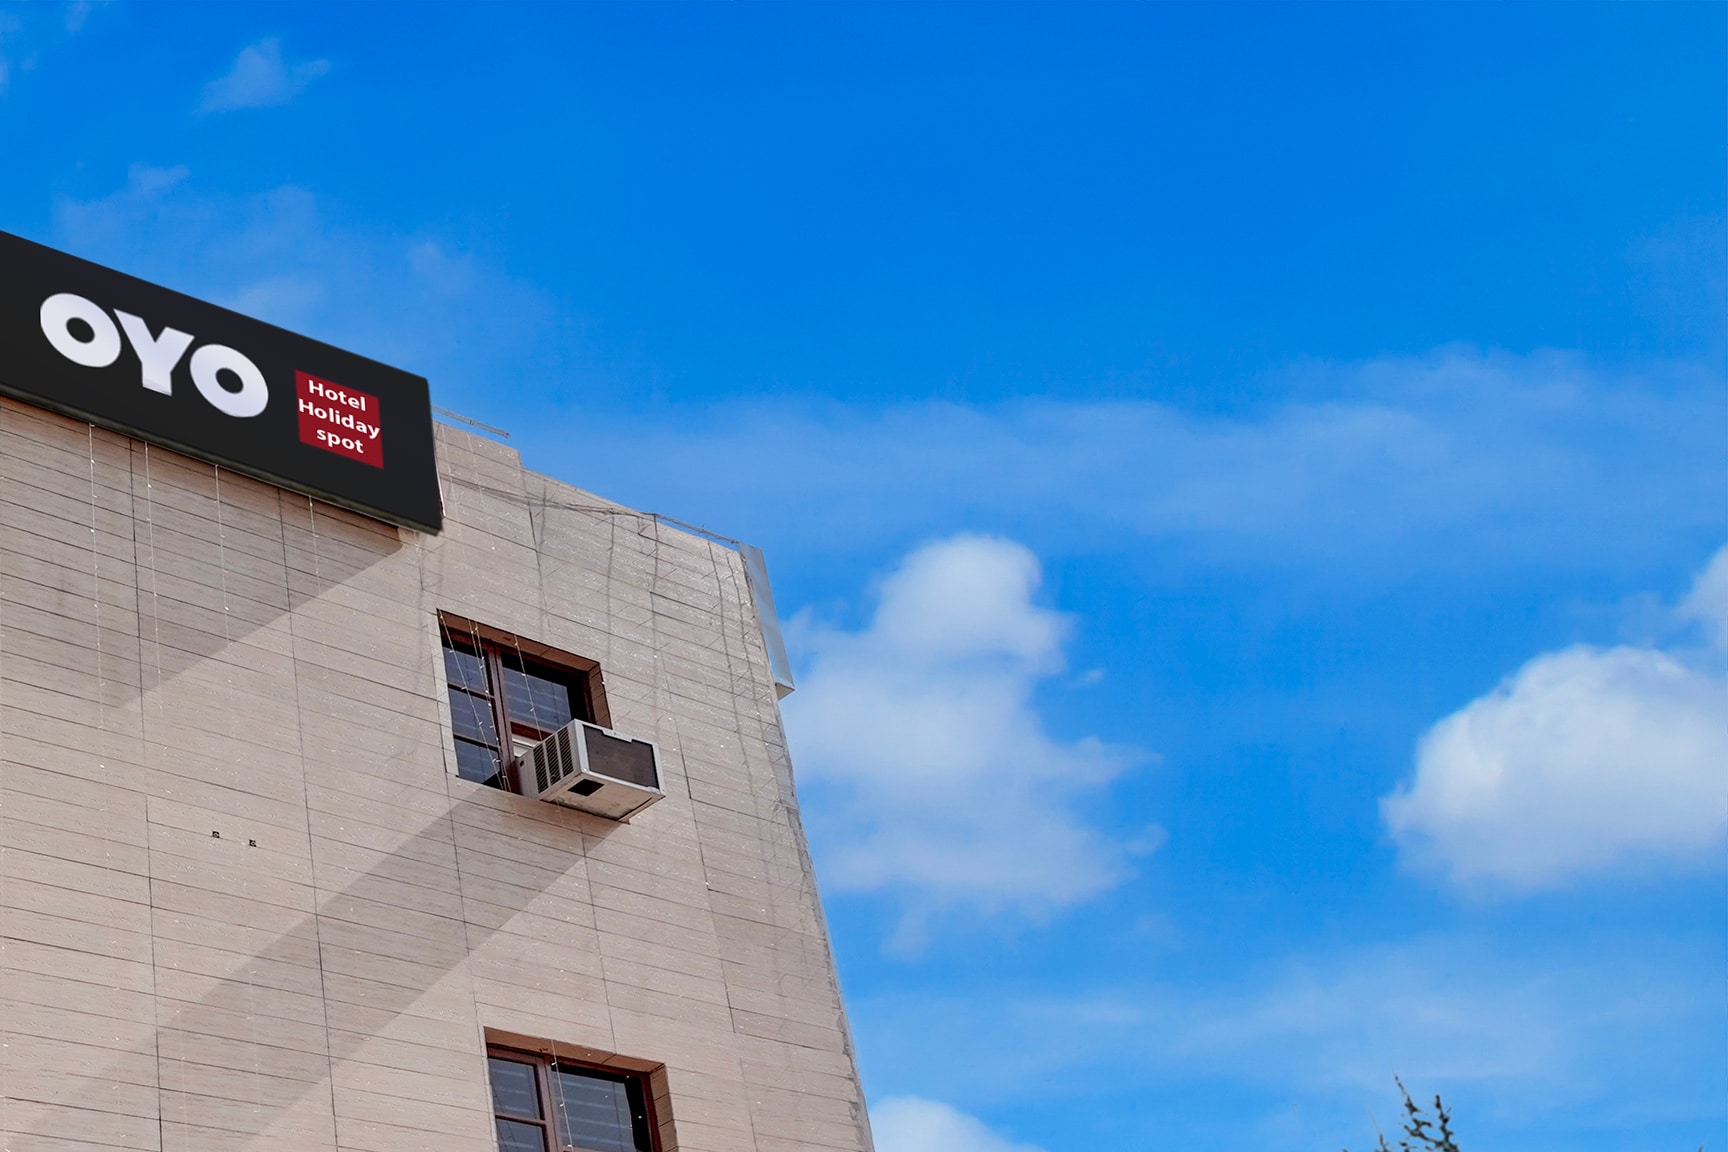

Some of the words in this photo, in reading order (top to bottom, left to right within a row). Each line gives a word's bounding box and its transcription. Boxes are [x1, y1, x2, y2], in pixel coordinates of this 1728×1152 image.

[40, 292, 269, 418] OYO
[308, 379, 366, 411] Hotel
[298, 398, 381, 440] Holiday
[316, 429, 364, 454] spot
